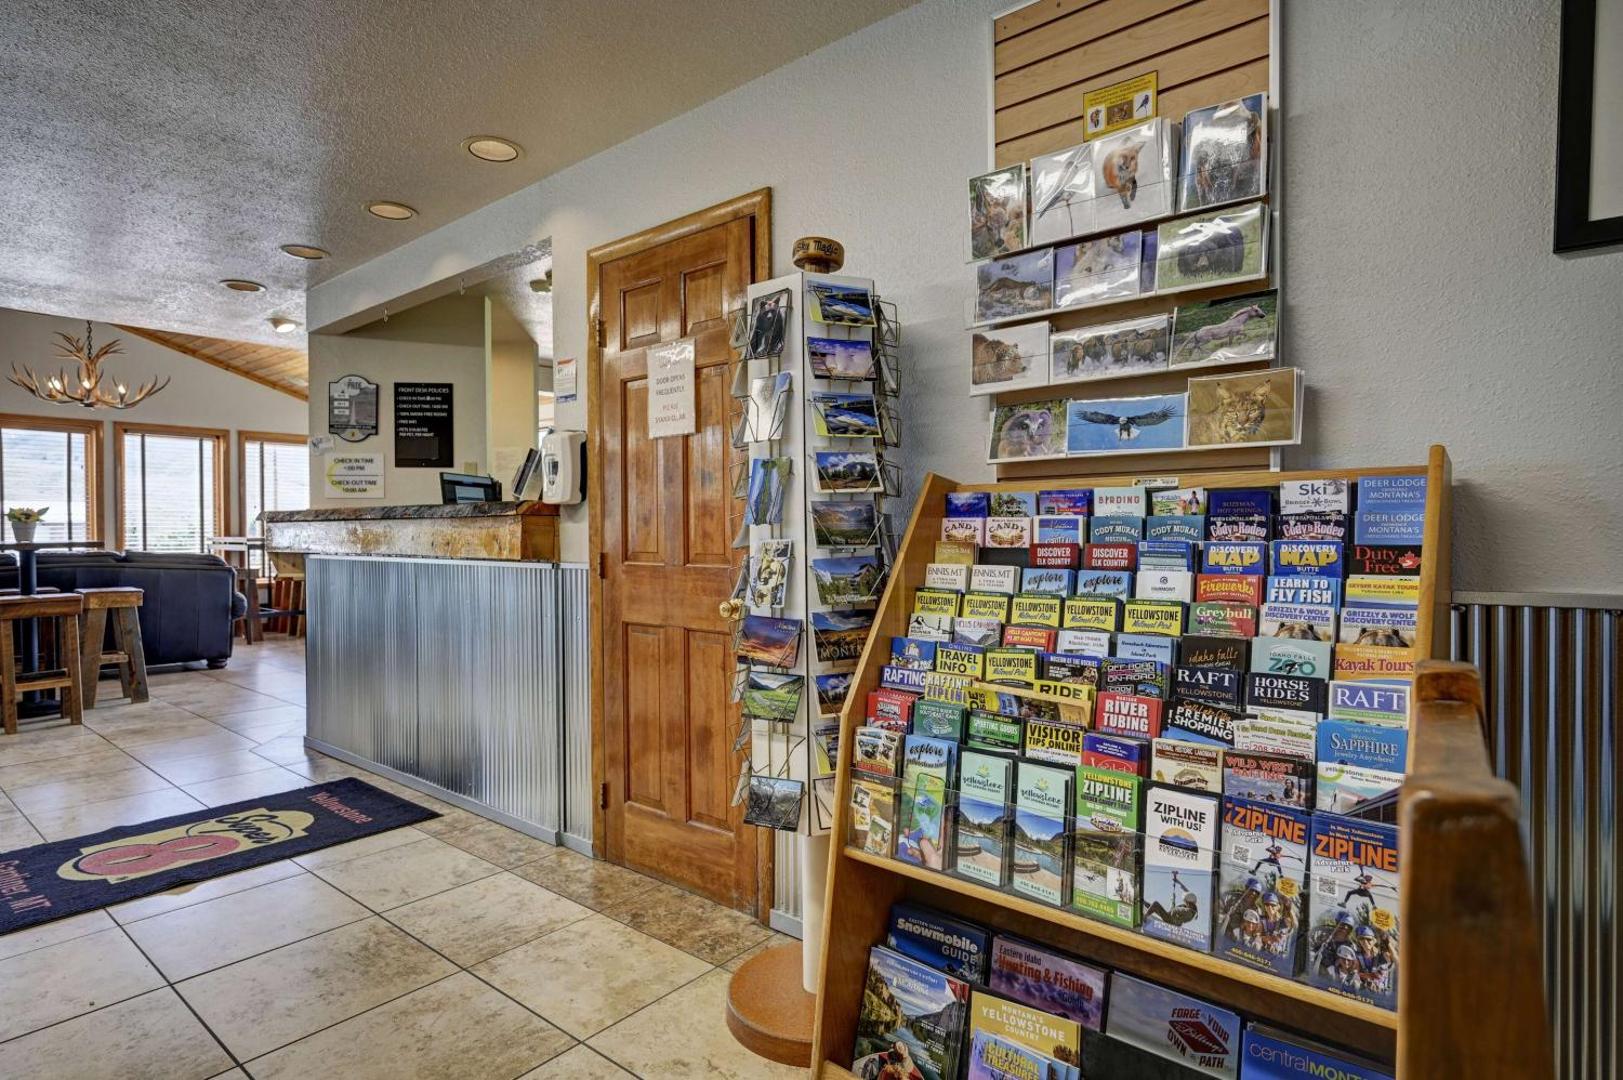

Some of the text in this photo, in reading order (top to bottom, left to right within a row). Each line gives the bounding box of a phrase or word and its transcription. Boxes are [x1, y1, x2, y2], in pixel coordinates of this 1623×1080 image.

[814, 240, 839, 256] Magic
[1299, 483, 1327, 496] Ski
[1364, 479, 1426, 488] DEER LODGE
[1098, 495, 1140, 506] BIRDING
[1370, 491, 1420, 499] MONTANA'S
[1363, 513, 1425, 522] DEER LODGE
[944, 522, 979, 533] CANDY
[988, 522, 1027, 533] CANDY
[1093, 525, 1141, 538] CODY MURAL
[1150, 525, 1199, 537] CODY MURAL
[1210, 522, 1233, 536] Cody
[1238, 521, 1267, 538] Rodeo
[1283, 521, 1306, 536] Cody
[1314, 520, 1345, 537] Rodeo
[1368, 526, 1420, 534] MONTANA'S
[1037, 547, 1071, 557] DISCOVER
[1092, 548, 1128, 558] DISCOVER
[1208, 551, 1260, 567] MAP
[1280, 550, 1338, 566] MAP
[1355, 546, 1398, 563] Duty
[1047, 558, 1071, 566] COUNTRY
[1092, 559, 1128, 567] ELK COUNTRY
[1365, 560, 1399, 574] Free
[998, 569, 1012, 578] MT
[1028, 572, 1064, 589] explore
[1083, 574, 1122, 592] explore
[1200, 579, 1254, 594] Fireworks
[1274, 578, 1328, 590] LEARN TO
[916, 594, 954, 606] YELLOWSTONE
[1270, 589, 1332, 604] FLY FISH
[966, 599, 1006, 610] YELLOWSTONE
[1015, 602, 1057, 613] YELLOWSTONE
[1066, 604, 1113, 616] YELLOWSTONE
[1267, 605, 1299, 614] GRIZZLY
[1305, 608, 1330, 616] WOLF
[1019, 611, 1052, 621] National Park
[1070, 614, 1107, 625] National Park
[1127, 609, 1179, 622] YELLOWSTONE
[1196, 606, 1252, 620] Greybull
[1265, 612, 1331, 622] DISCOVERY CENTER
[1344, 616, 1385, 625] DISCOVERY
[1347, 610, 1380, 618] GRIZZLY
[1388, 612, 1415, 620] WOLF
[1131, 617, 1173, 629] National Park
[948, 644, 973, 652] ONLINE
[940, 649, 978, 665] TRAVEL
[988, 656, 1032, 669] YELLOWSTONE
[940, 660, 967, 674] INFO
[993, 667, 1027, 676] National Park
[1268, 656, 1317, 676] ZOO
[1336, 658, 1414, 674] Kayak Tours
[884, 667, 926, 685] RAFTING
[1177, 669, 1234, 687] RAFT
[1254, 676, 1310, 691] HORSE
[1040, 683, 1083, 700] RIDE
[1177, 687, 1233, 699] YELLOWSTONE
[1254, 687, 1310, 702] RIDES
[1336, 687, 1405, 711] RAFT
[1104, 698, 1148, 716] RIVER
[1103, 712, 1149, 733] TUBING
[1176, 706, 1234, 731] PREMIER
[1029, 724, 1081, 743] VISITOR
[1174, 714, 1233, 740] SHOPPING
[909, 742, 944, 760] explore
[1028, 736, 1081, 753] TIPS ONLINE
[1330, 733, 1399, 756] SAPPHIRE
[1226, 756, 1257, 769] WILD
[1260, 759, 1295, 773] WEST
[1083, 772, 1133, 790] YELLOWSTONE
[1231, 767, 1286, 780] RAFTING
[963, 776, 1004, 791] yellowstone
[1021, 789, 1063, 806] yellowstone
[1083, 779, 1132, 804] ZIPLINE
[308, 791, 374, 825] Yellowstone
[1153, 801, 1206, 824] ZIPLINE
[208, 813, 277, 845] Super
[1160, 814, 1202, 832] WITH US!
[1232, 805, 1308, 846] ZIPLINE
[1351, 828, 1384, 839] Yellowstone
[1314, 833, 1399, 873] ZIPLINE
[896, 917, 978, 953] Snowmobile
[941, 945, 977, 965] GUIDE
[999, 944, 1042, 966] Eastern Idaho
[997, 954, 1094, 1004] Hunting & Fishing
[1002, 1004, 1044, 1024] MONTANA'S
[982, 1006, 1066, 1042] YELLOWSTONE
[1171, 1007, 1230, 1045] FORGE YOUR
[1005, 1026, 1040, 1041] COUNTRY
[1167, 1028, 1225, 1069] OWN PATH
[985, 1040, 1039, 1074] CULTURAL
[986, 1054, 1039, 1080] TREASURES
